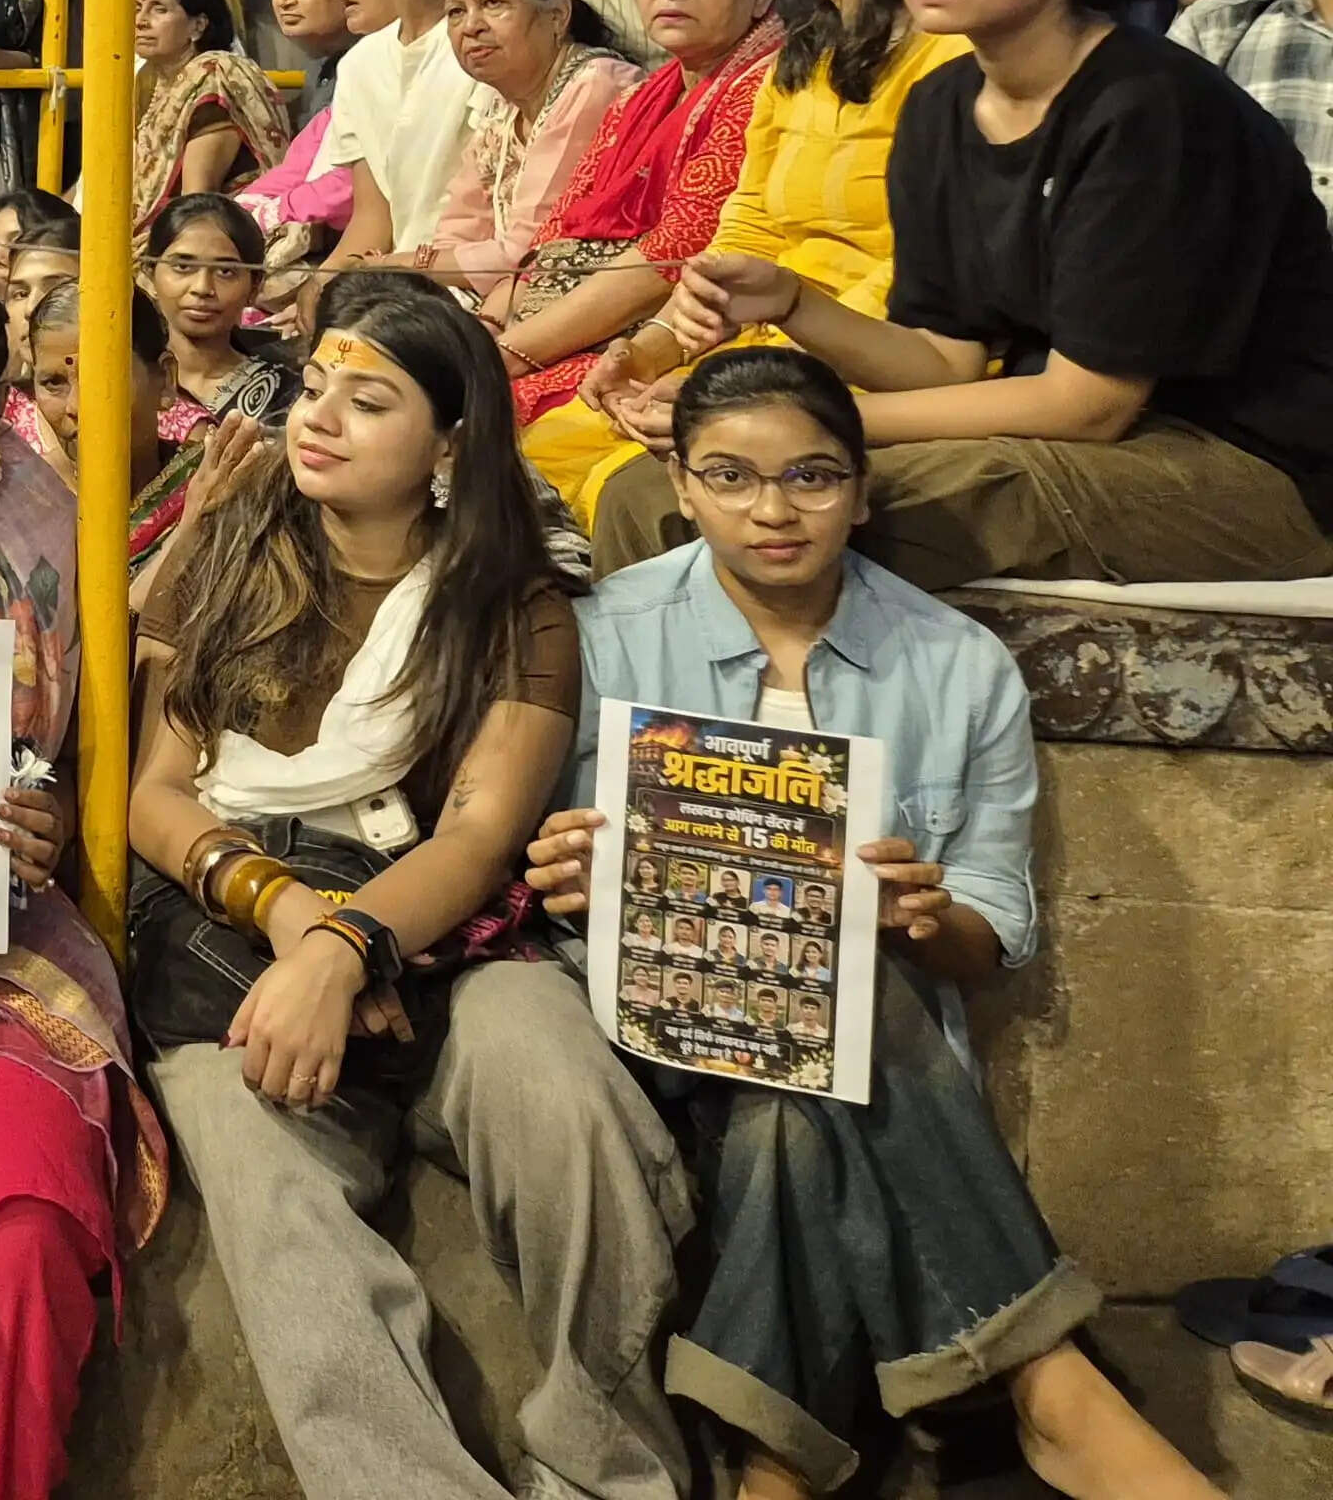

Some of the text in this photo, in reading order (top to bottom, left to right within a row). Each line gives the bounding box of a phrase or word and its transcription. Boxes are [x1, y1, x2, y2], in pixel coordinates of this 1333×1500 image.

[704, 735, 773, 762] भावपूर्ण
[662, 751, 825, 808] श्रद्धांजलि
[663, 818, 818, 854] आग लगने से 15 की मौत
